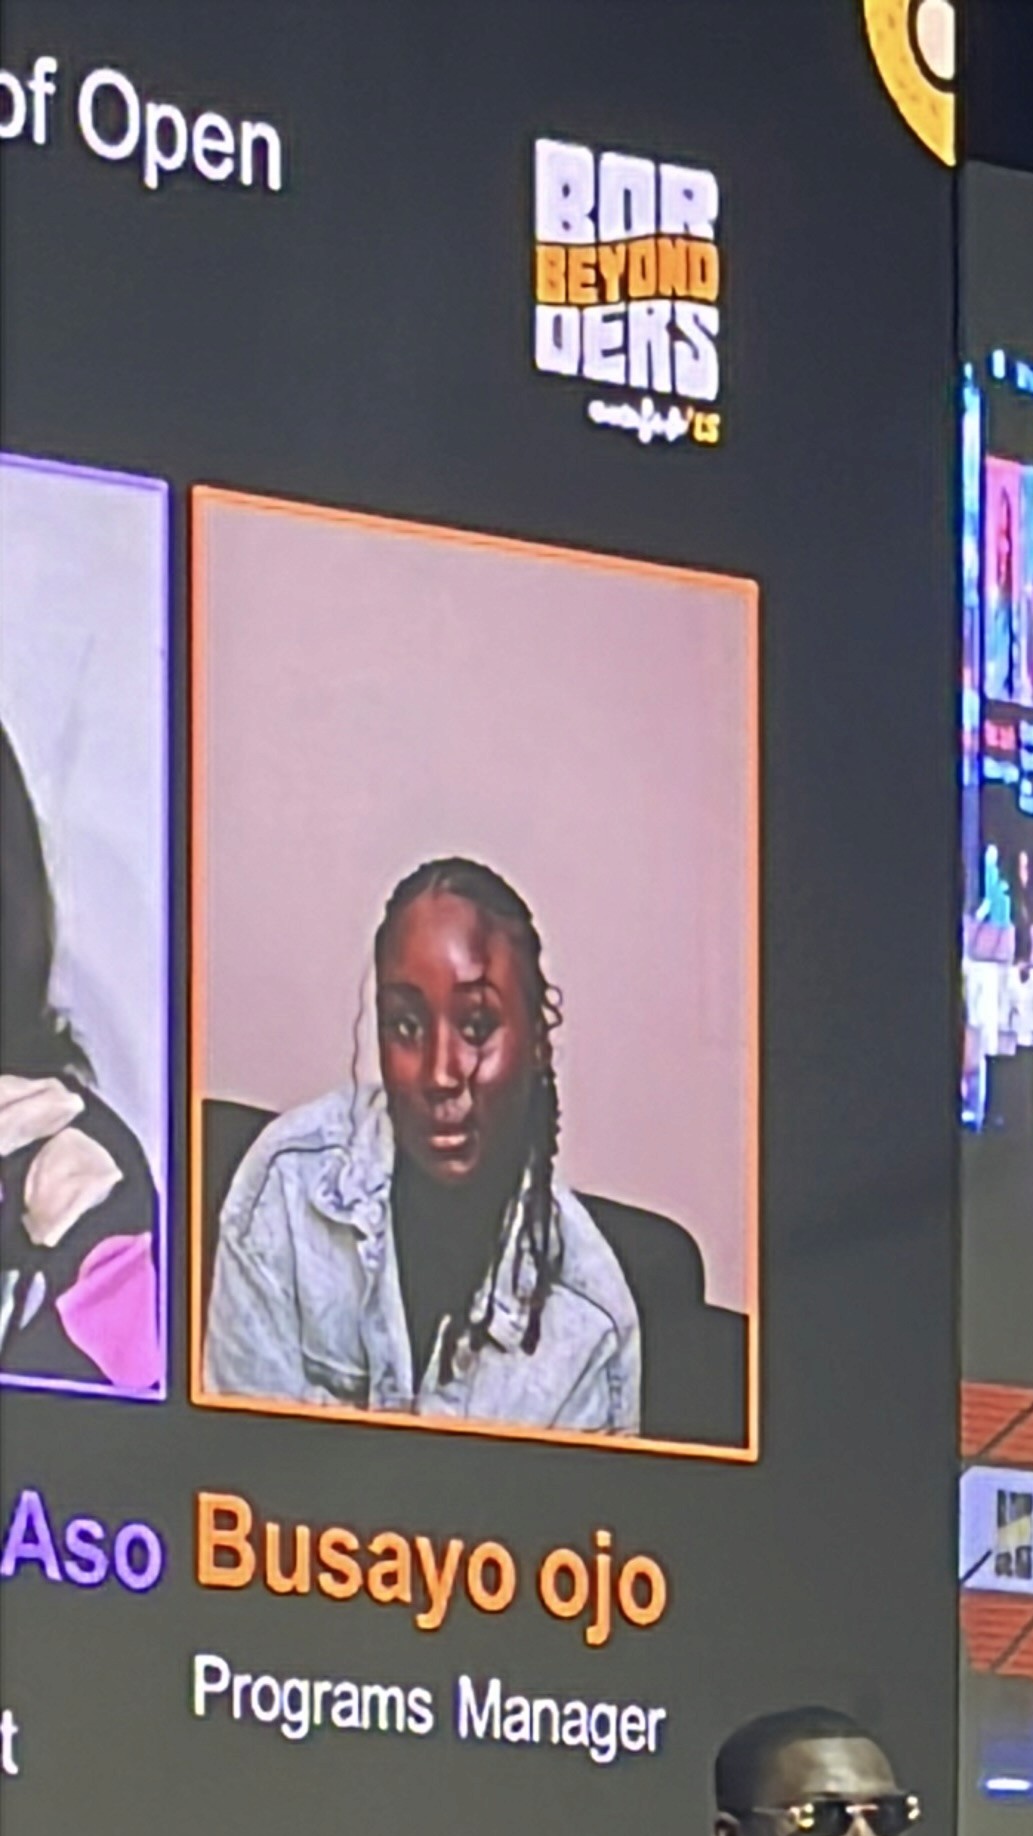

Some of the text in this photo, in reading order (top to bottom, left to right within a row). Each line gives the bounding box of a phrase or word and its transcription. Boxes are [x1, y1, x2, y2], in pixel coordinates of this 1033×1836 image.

[0, 56, 281, 190] of Open
[535, 139, 718, 243] BOR
[537, 238, 719, 305] BEYOND
[535, 300, 719, 401] DERS
[0, 1490, 163, 1590] Aso
[196, 1492, 667, 1645] Busayo ojo
[193, 1654, 666, 1764] Programs Manager
